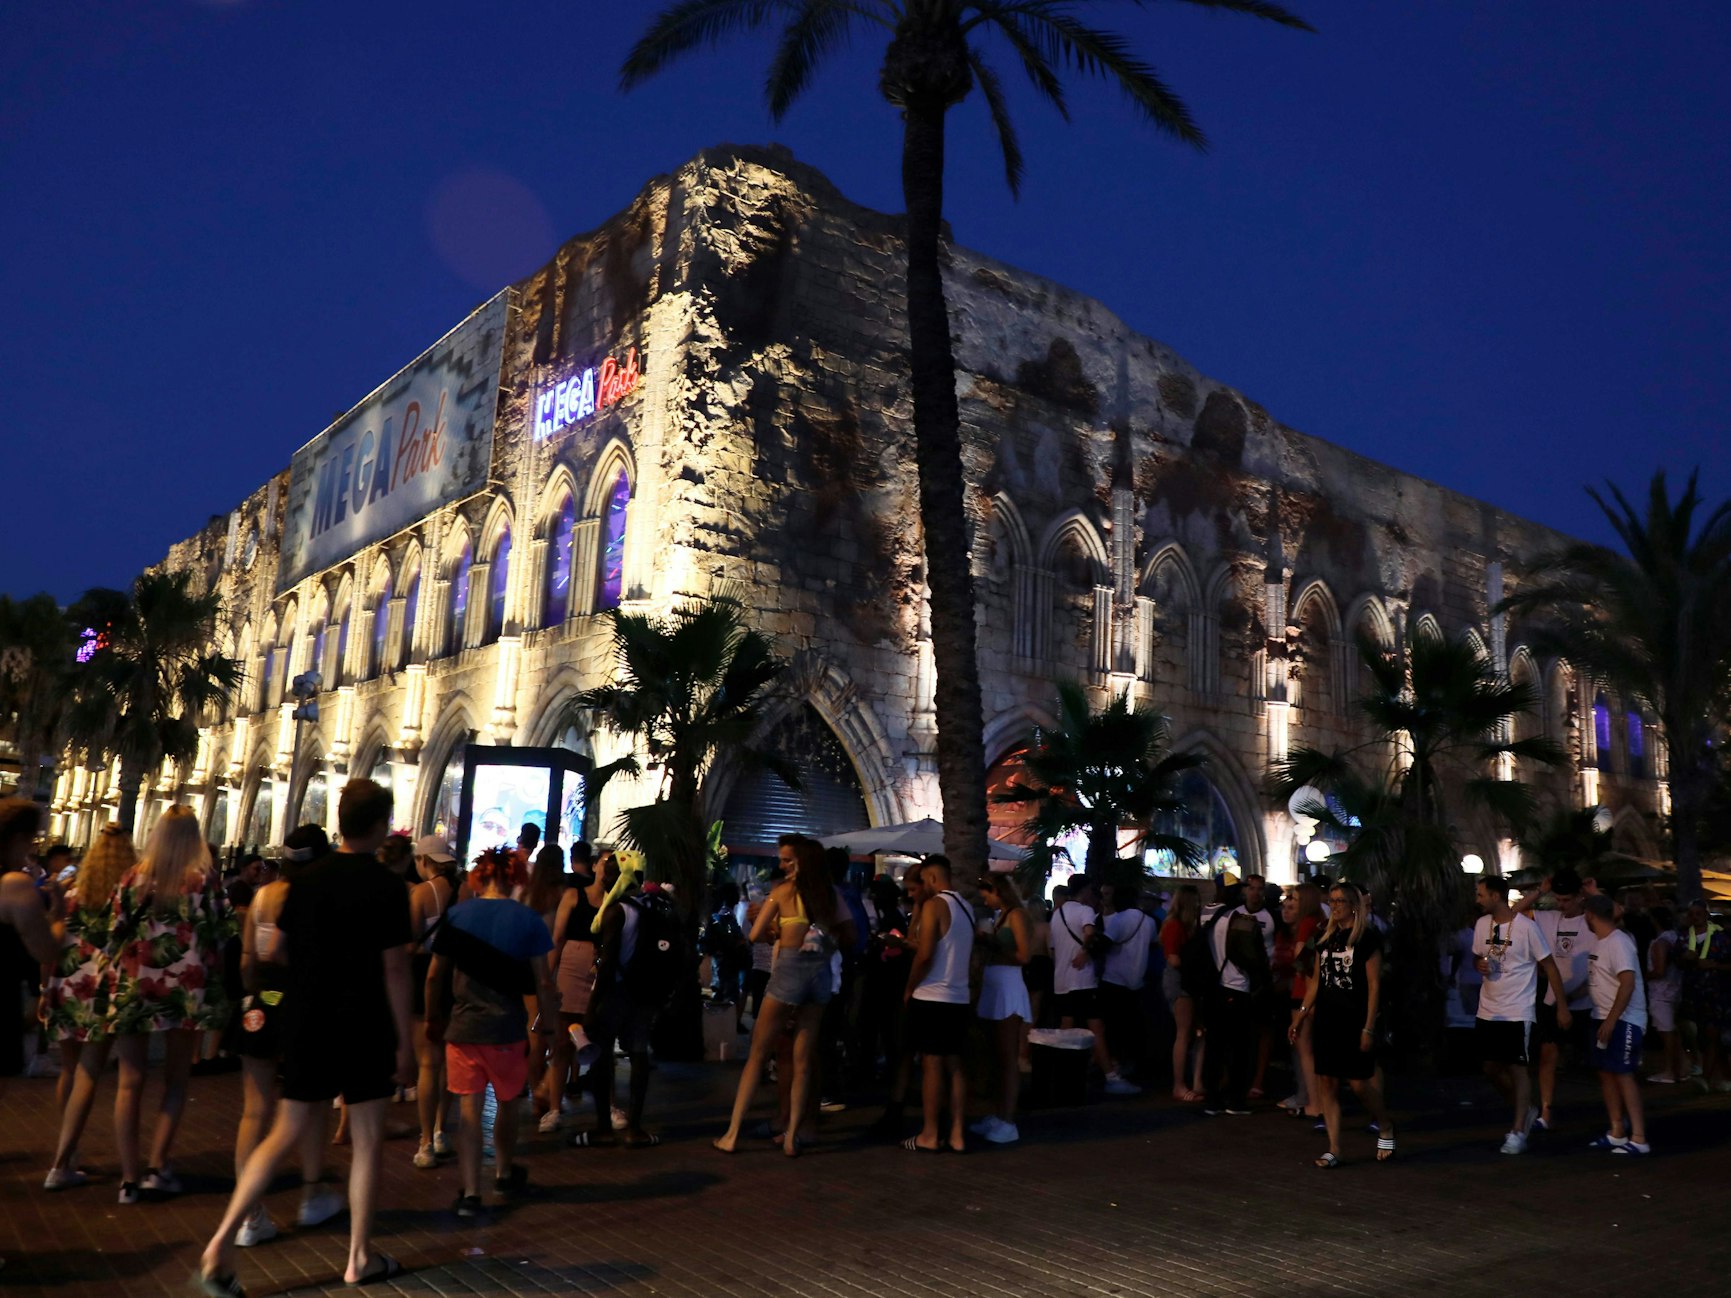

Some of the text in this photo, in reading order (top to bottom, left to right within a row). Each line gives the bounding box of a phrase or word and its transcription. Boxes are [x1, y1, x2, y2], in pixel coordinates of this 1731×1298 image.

[534, 346, 640, 442] MEGA Park
[310, 391, 447, 541] MEGA Park
